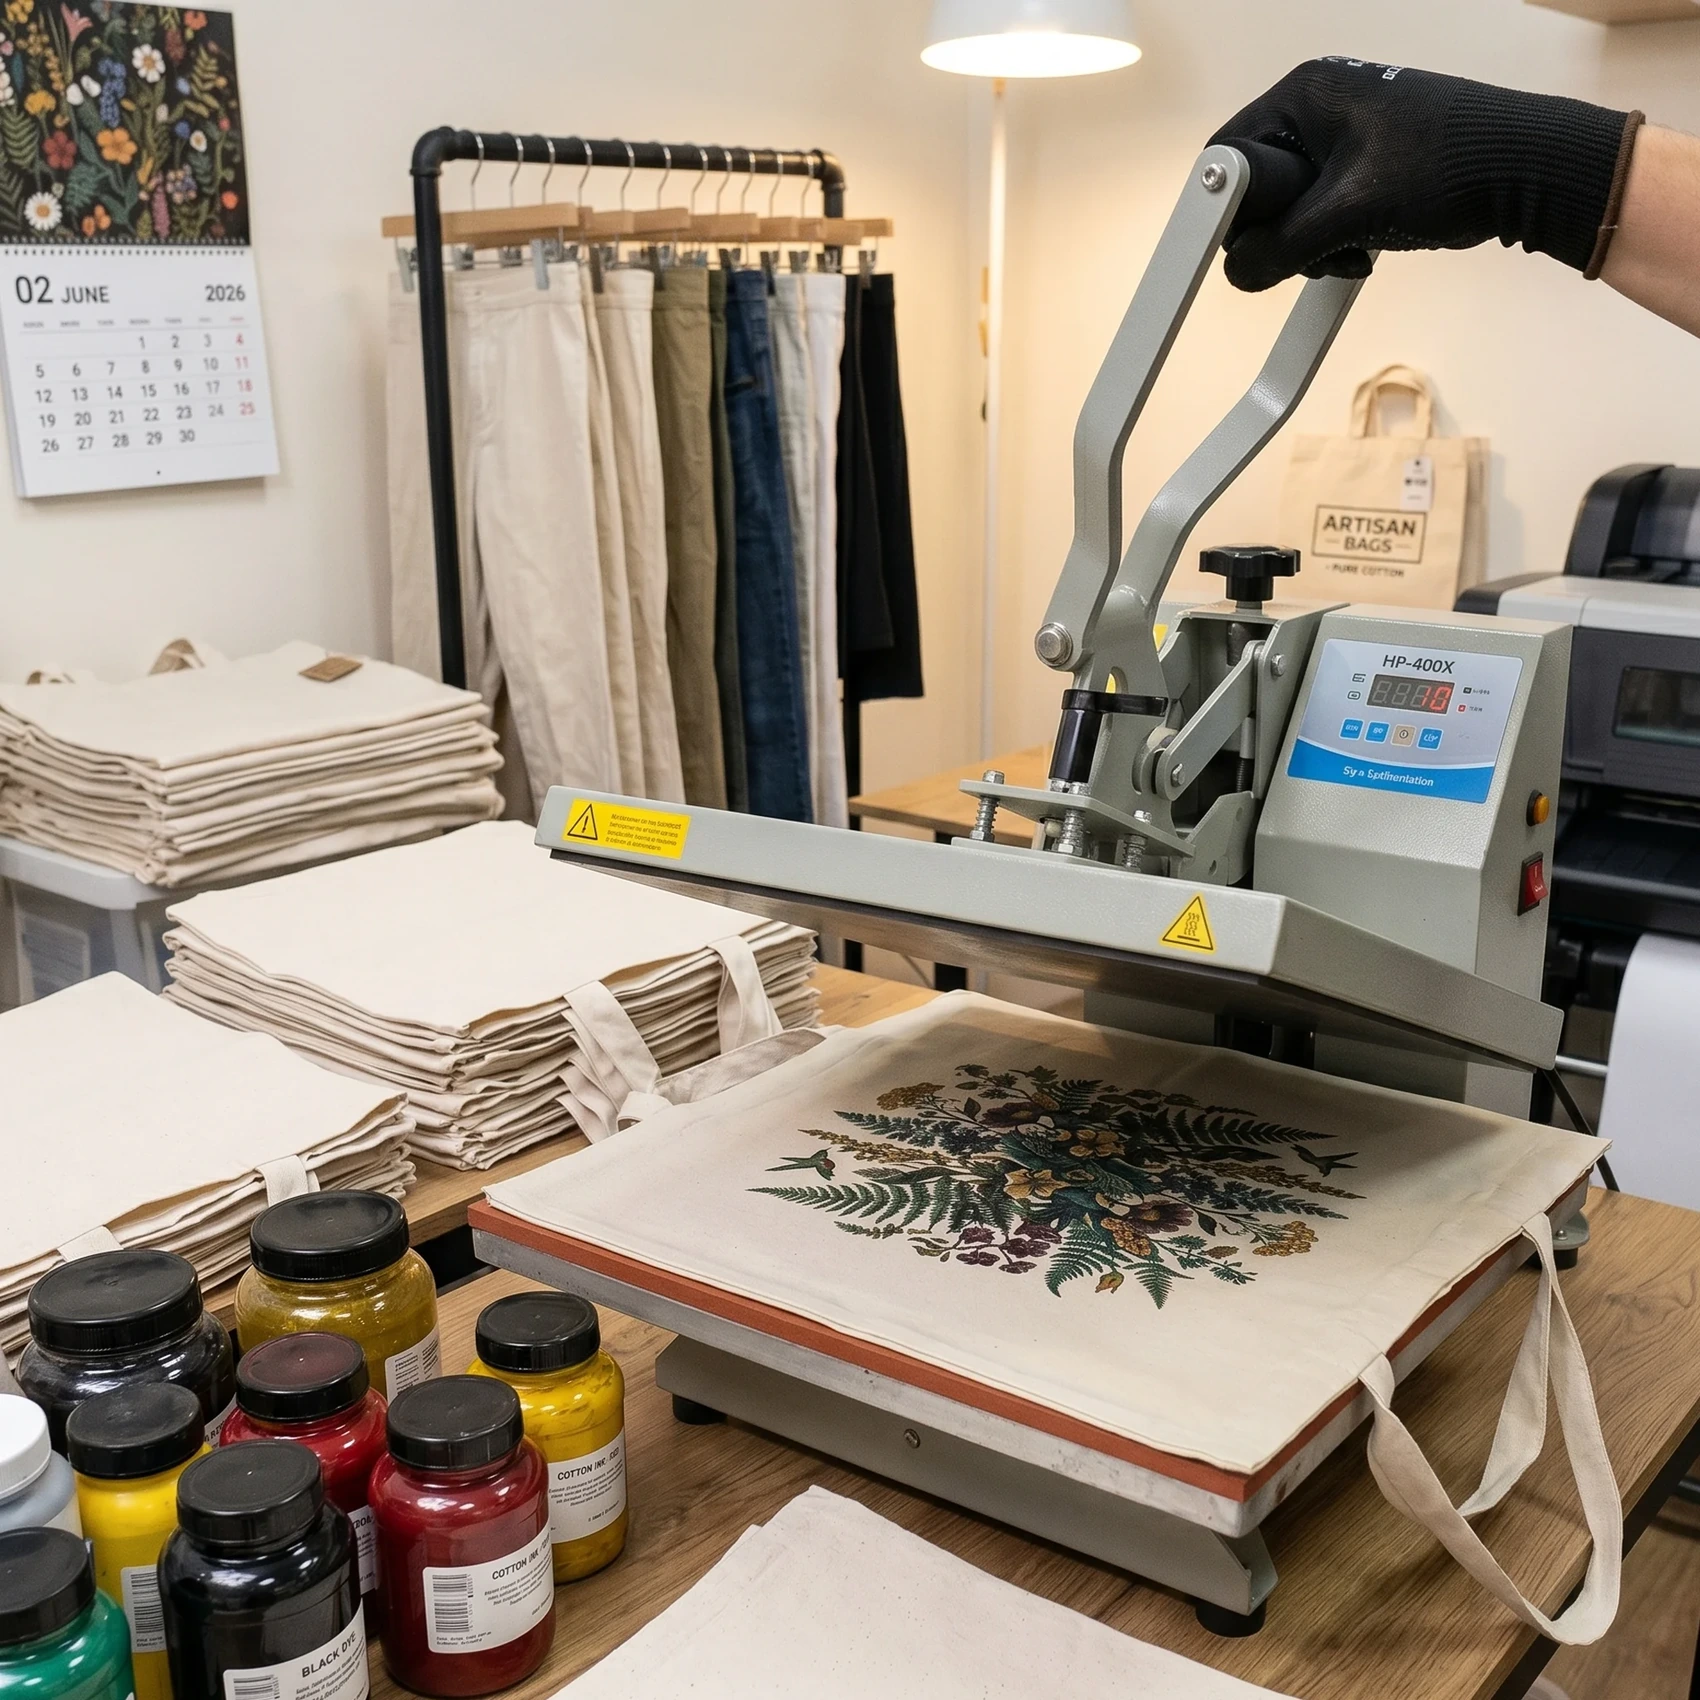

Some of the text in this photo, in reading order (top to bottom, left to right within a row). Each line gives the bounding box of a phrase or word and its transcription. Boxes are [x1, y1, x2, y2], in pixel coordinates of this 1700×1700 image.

[16, 276, 245, 304] 02 JUNE 2026
[138, 335, 146, 349] 1
[171, 334, 180, 349] 2
[203, 332, 213, 348] 3
[35, 355, 249, 379] 5 6 7 8 9 10 11
[35, 388, 53, 404] 12
[71, 386, 89, 402] 13
[107, 385, 123, 399] 14
[140, 383, 158, 398] 15
[173, 382, 190, 396] 16
[205, 379, 221, 394] 17
[39, 413, 57, 428] 19
[73, 411, 92, 427] 20
[109, 409, 125, 425] 21
[143, 407, 160, 422] 22
[175, 404, 193, 421] 23
[207, 403, 225, 418] 24
[41, 428, 196, 454] 26 27 28 29 30
[1322, 514, 1416, 537] ARTISAN
[1344, 536, 1393, 553] BAGS
[1382, 654, 1455, 675] HP-400X
[557, 1463, 593, 1481] COTTON
[492, 1557, 527, 1580] COTTON
[302, 1631, 356, 1678] BLACK DYE
